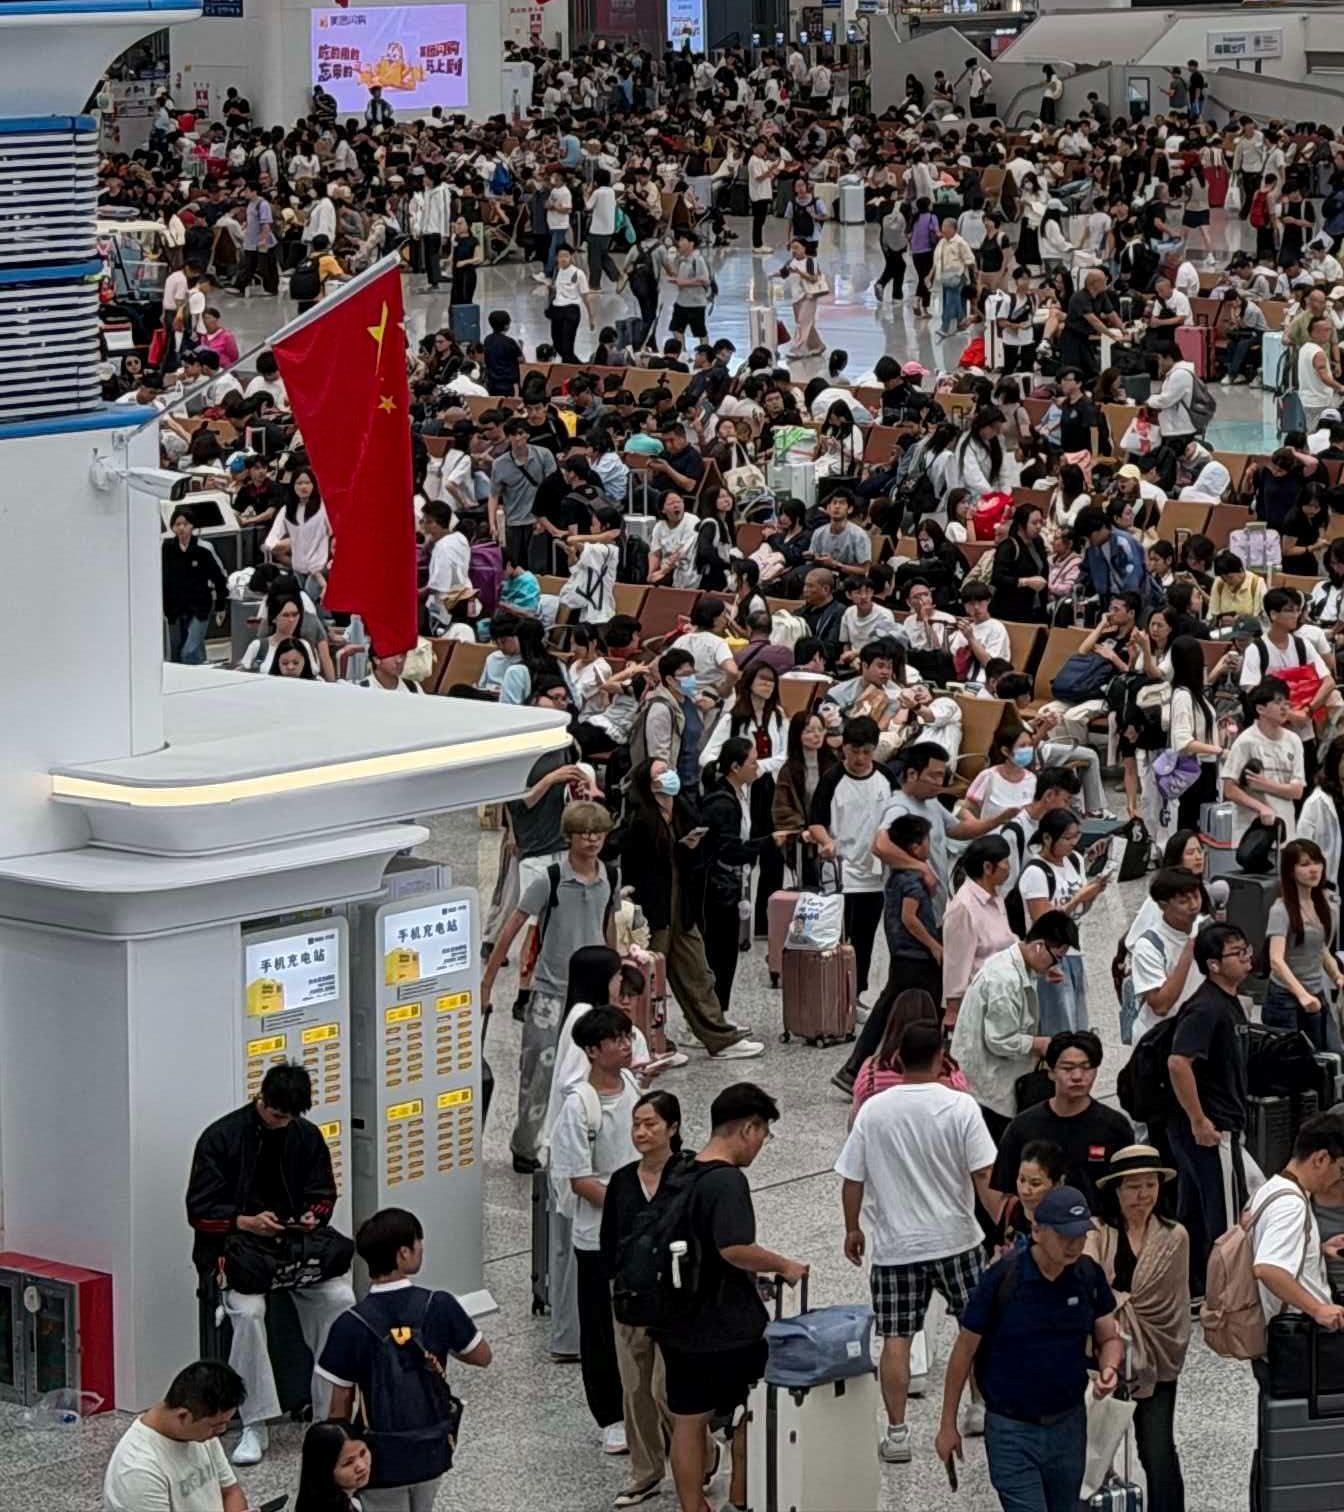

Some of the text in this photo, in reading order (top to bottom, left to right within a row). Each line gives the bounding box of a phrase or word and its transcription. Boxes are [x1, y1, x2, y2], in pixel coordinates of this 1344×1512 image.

[397, 919, 458, 943] 手机充电站
[261, 948, 326, 974] 手机充电站
